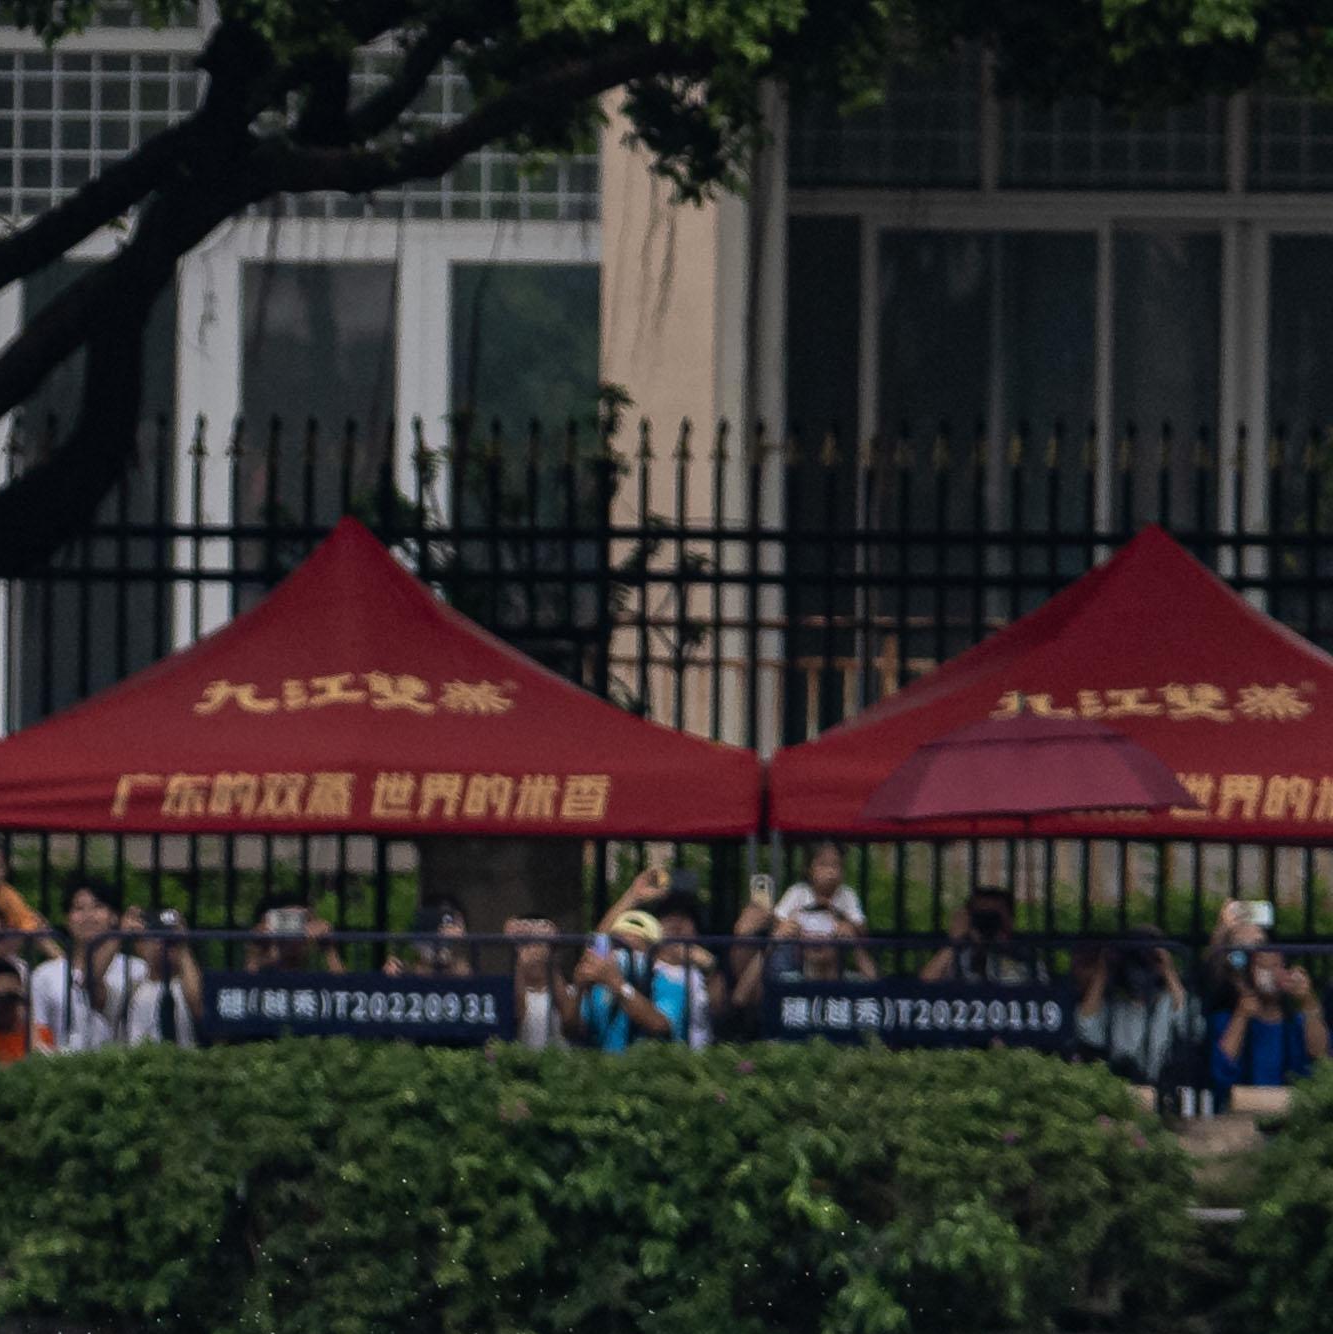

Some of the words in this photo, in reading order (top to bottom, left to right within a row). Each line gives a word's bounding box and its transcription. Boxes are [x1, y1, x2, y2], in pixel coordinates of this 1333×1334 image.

[112, 772, 355, 818] 广东的双蒸
[370, 772, 611, 822] 世界的米香
